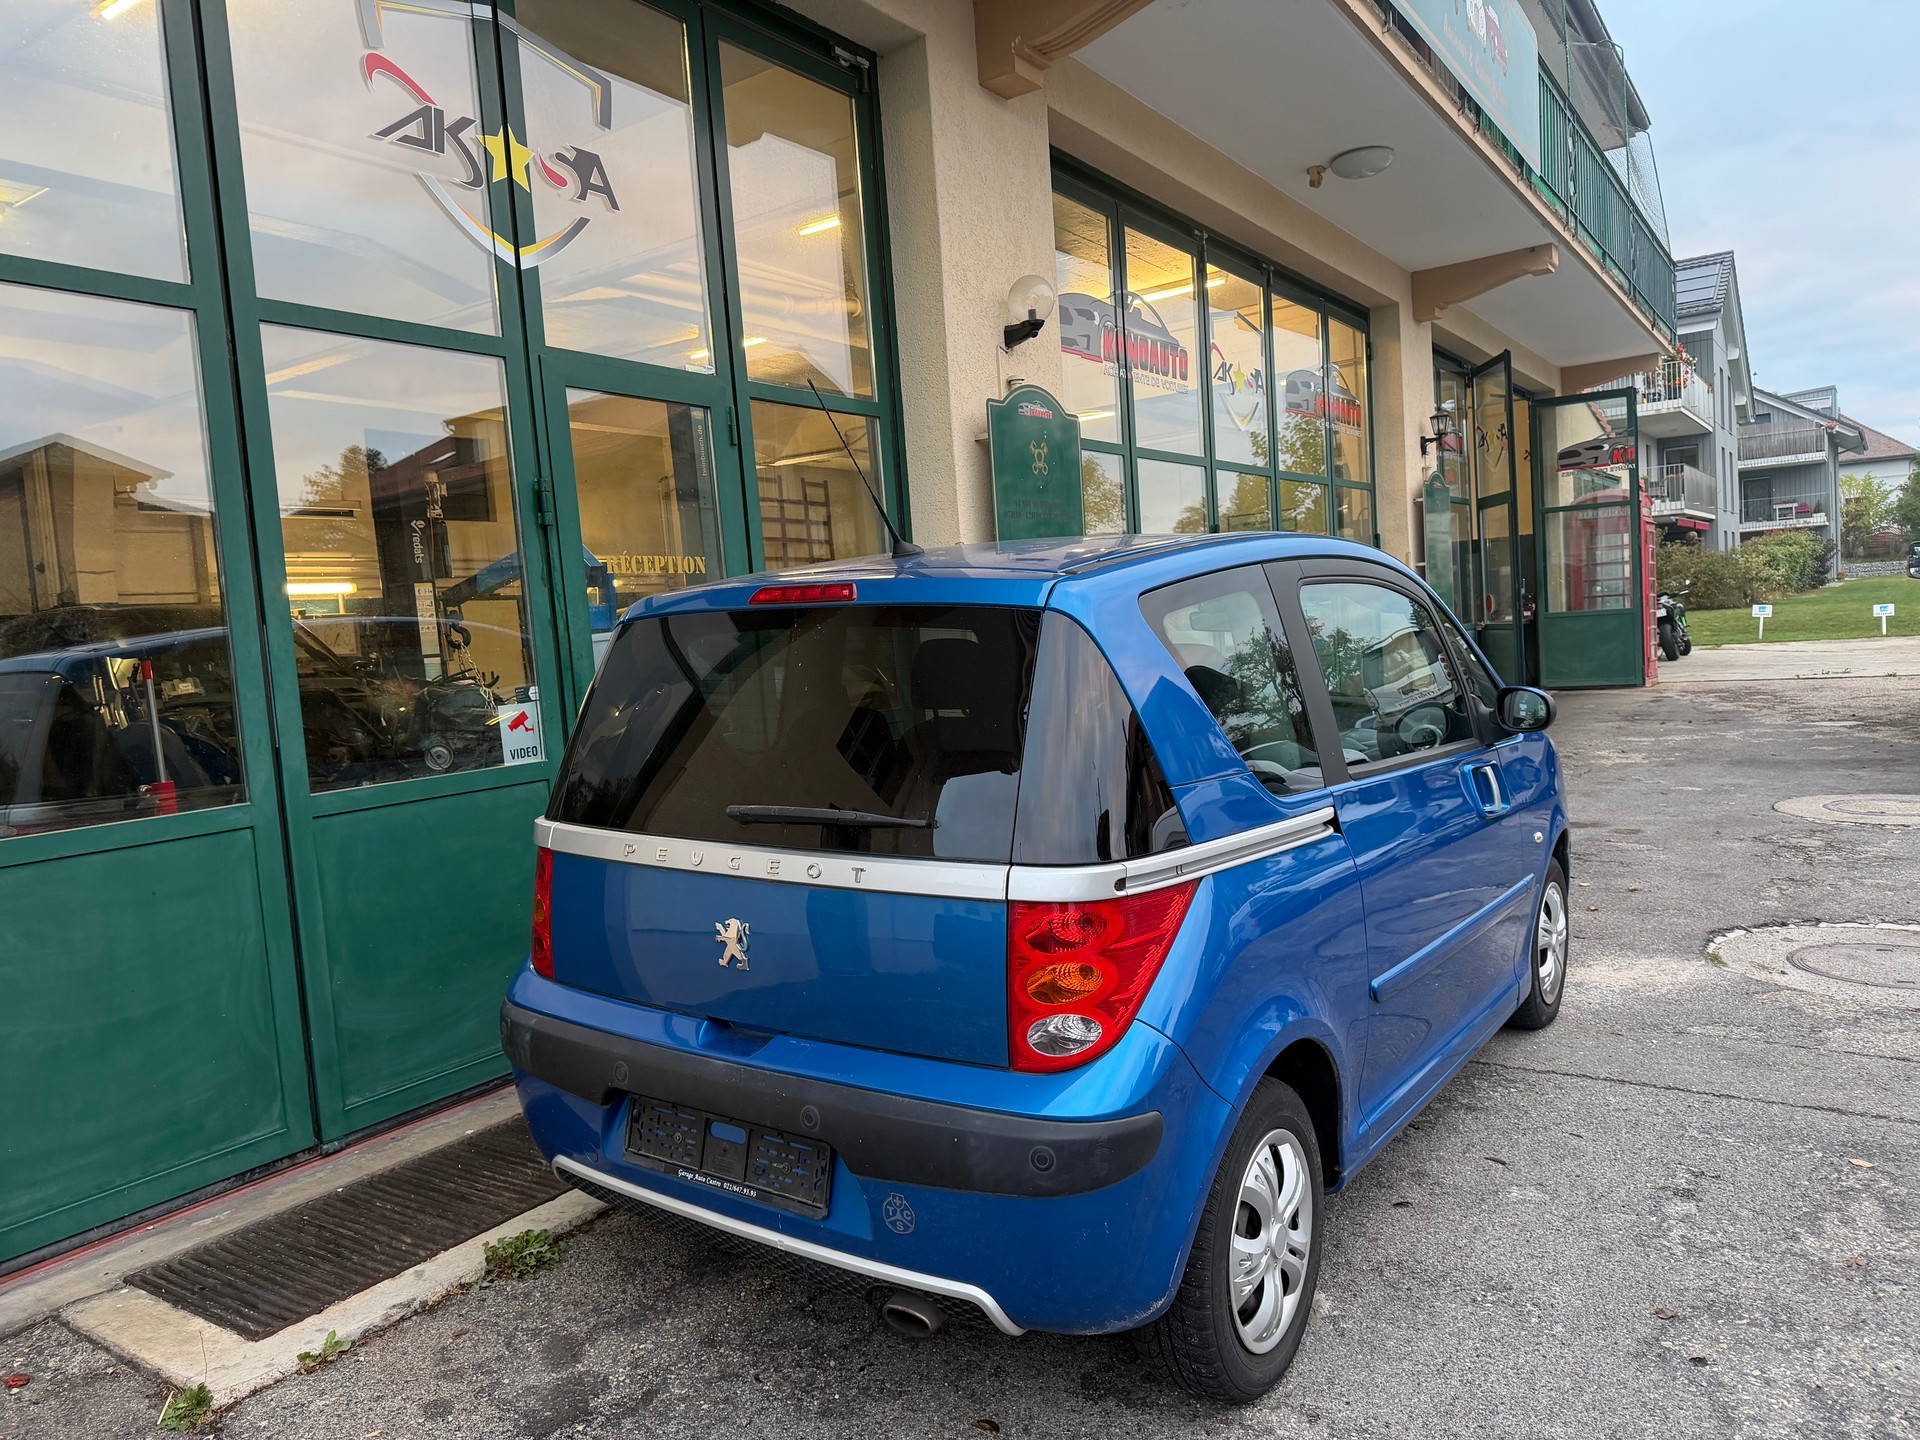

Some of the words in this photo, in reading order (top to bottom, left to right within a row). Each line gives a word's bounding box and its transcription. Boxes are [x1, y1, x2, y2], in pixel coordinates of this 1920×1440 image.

[697, 424, 707, 476] twinbusch.de
[411, 532, 424, 564] redats
[605, 550, 706, 574] RÉCEPTION
[509, 745, 538, 760] VIDEO
[623, 843, 867, 884] PEUGEOT
[678, 1168, 694, 1180] Garage
[694, 1173, 706, 1182] Auto
